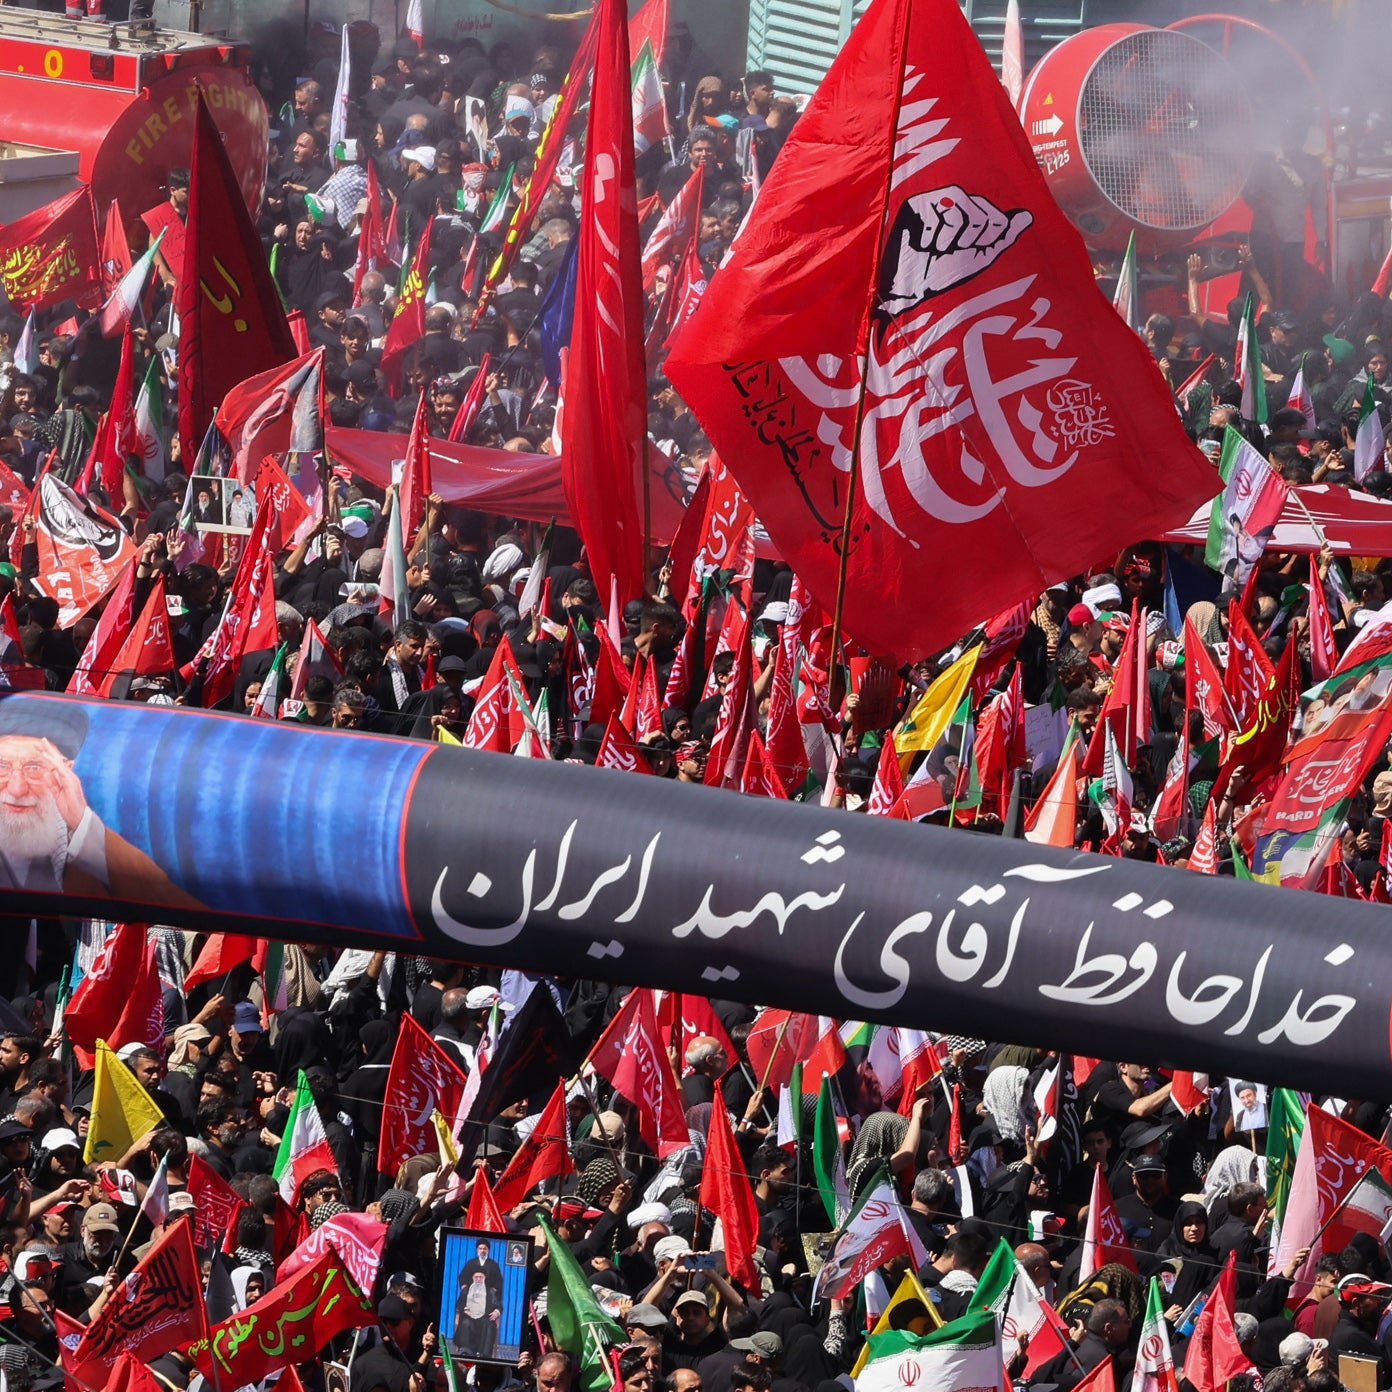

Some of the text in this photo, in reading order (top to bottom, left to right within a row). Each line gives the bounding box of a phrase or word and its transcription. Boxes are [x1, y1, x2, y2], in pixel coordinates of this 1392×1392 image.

[125, 97, 185, 165] FIRE
[431, 818, 1357, 1047] خداحافظ آقای شهید ایران
